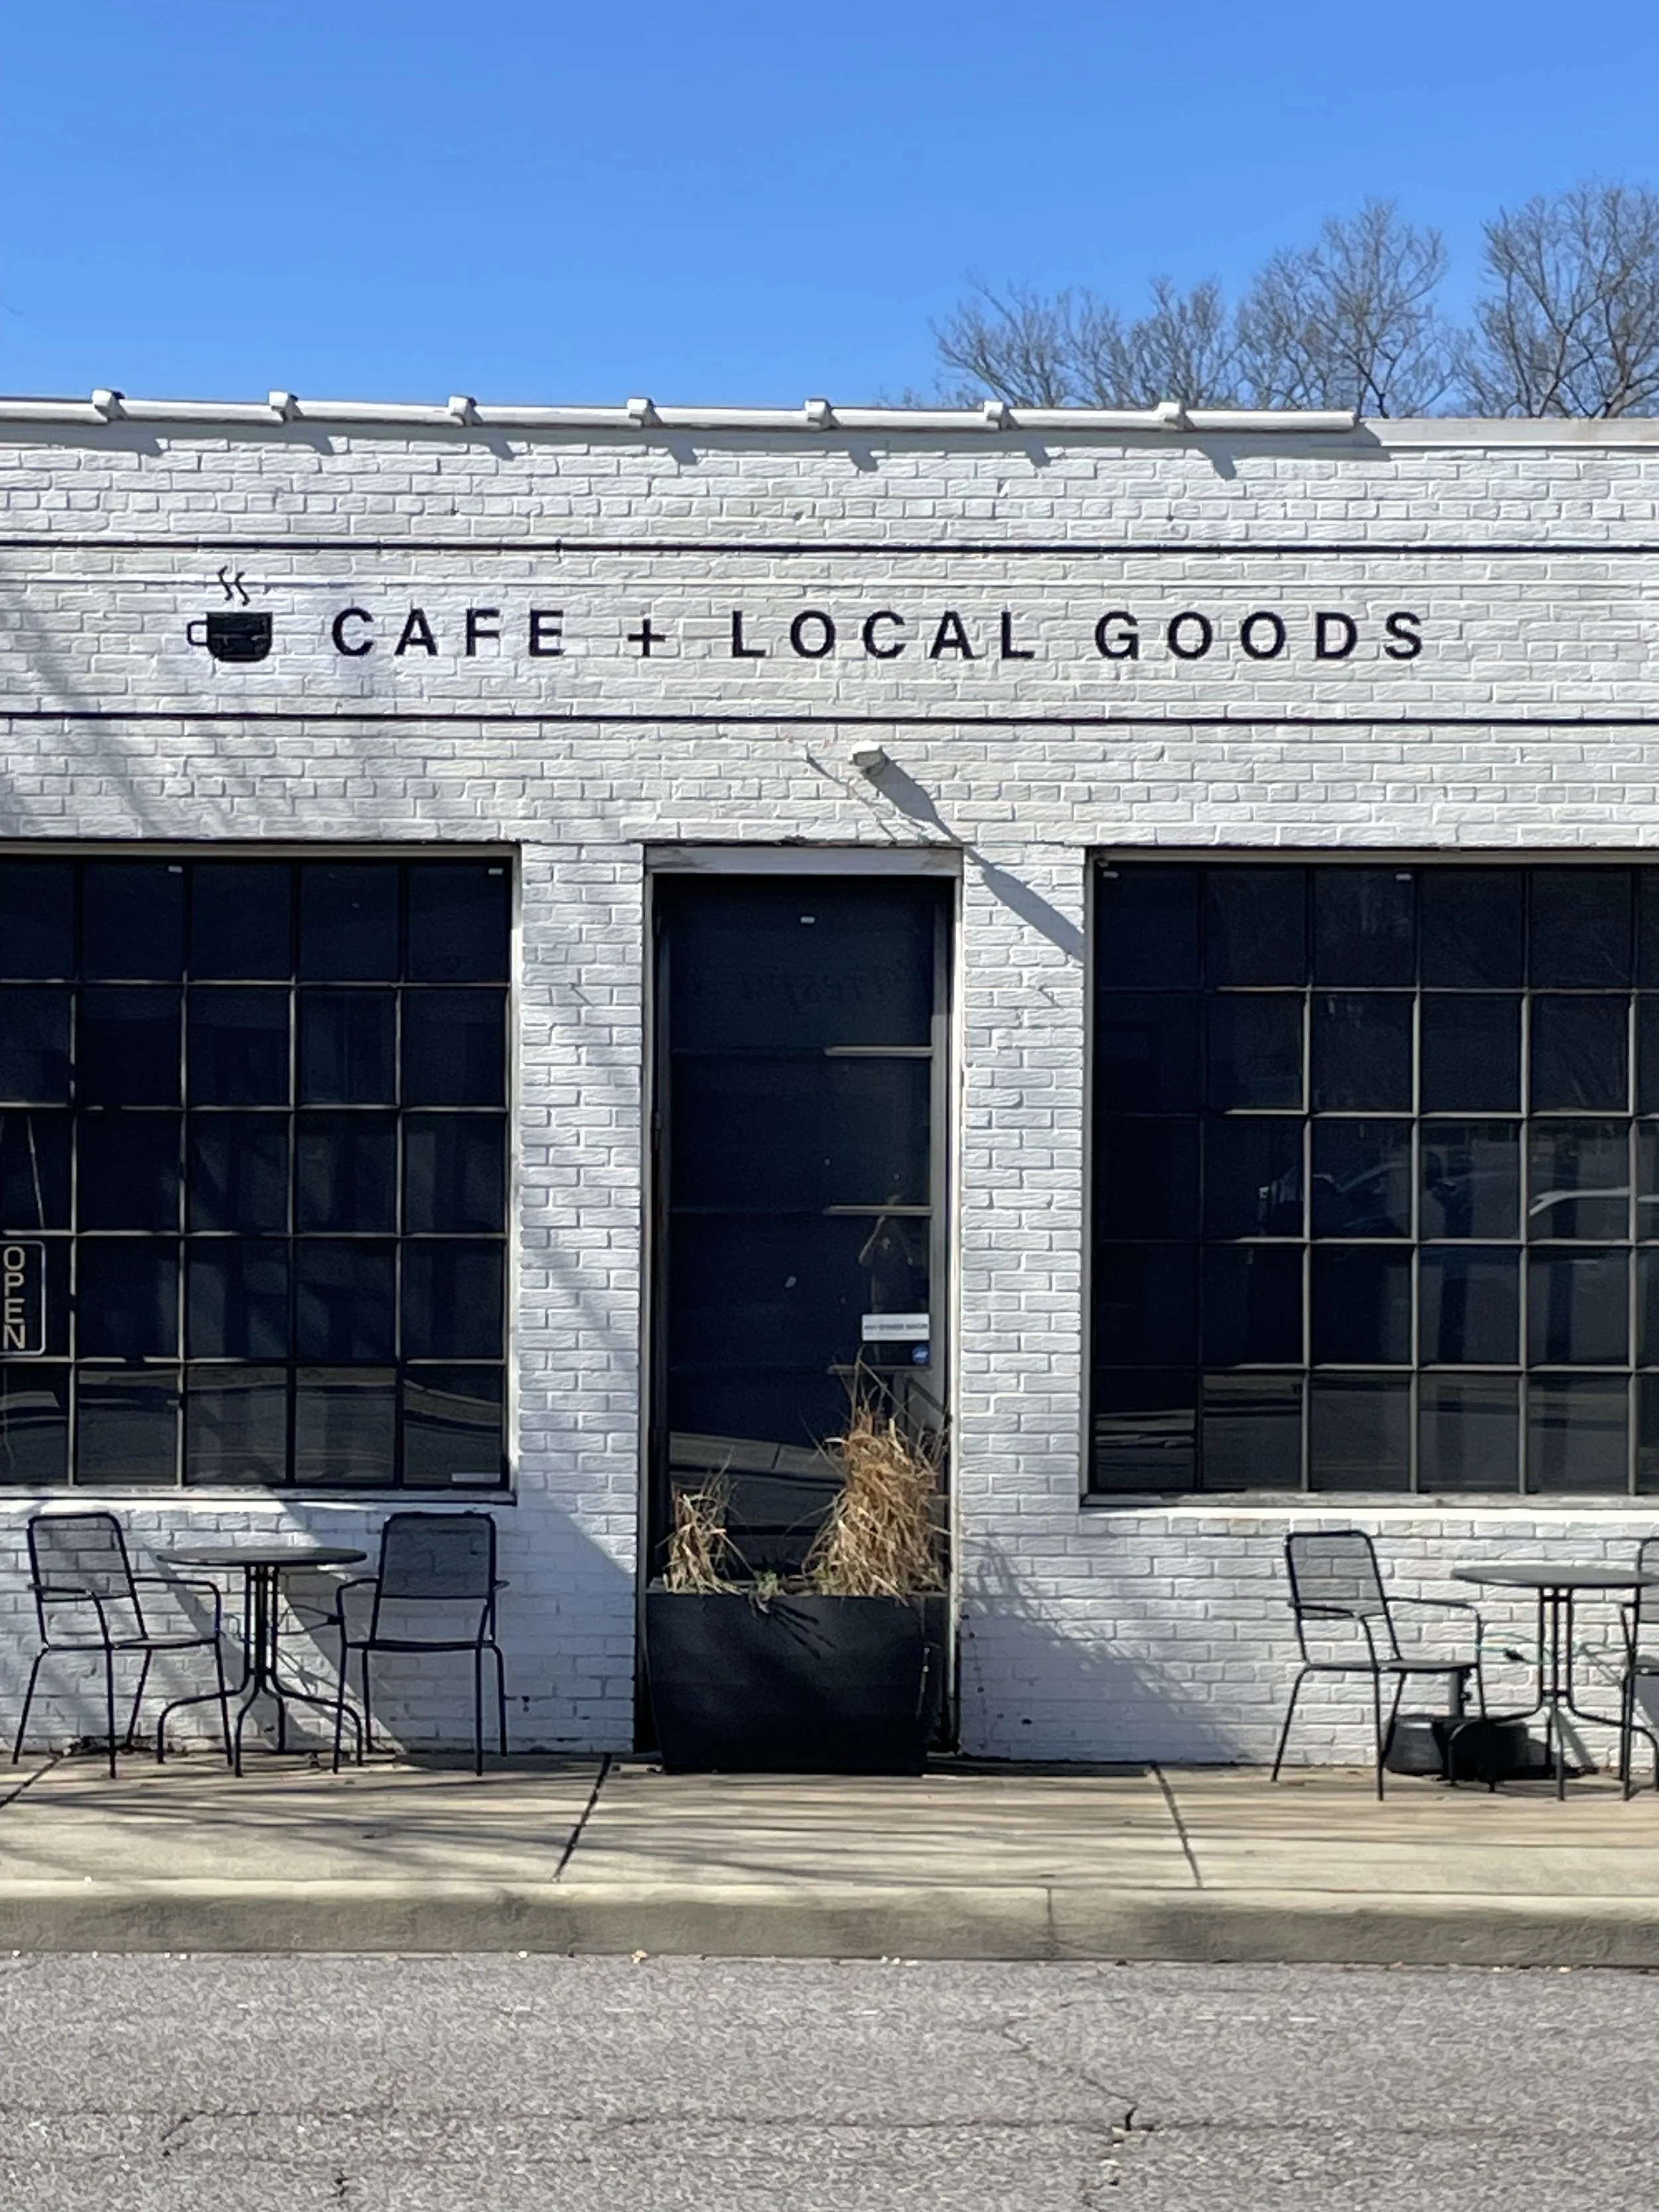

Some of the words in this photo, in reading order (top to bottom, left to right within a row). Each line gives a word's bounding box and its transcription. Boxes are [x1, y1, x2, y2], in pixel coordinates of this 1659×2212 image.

[331, 607, 565, 657] CAFE
[627, 619, 667, 658] +
[731, 610, 1035, 660] LOCAL
[1094, 611, 1422, 661] GOODS
[3, 1246, 25, 1349] OPEN
